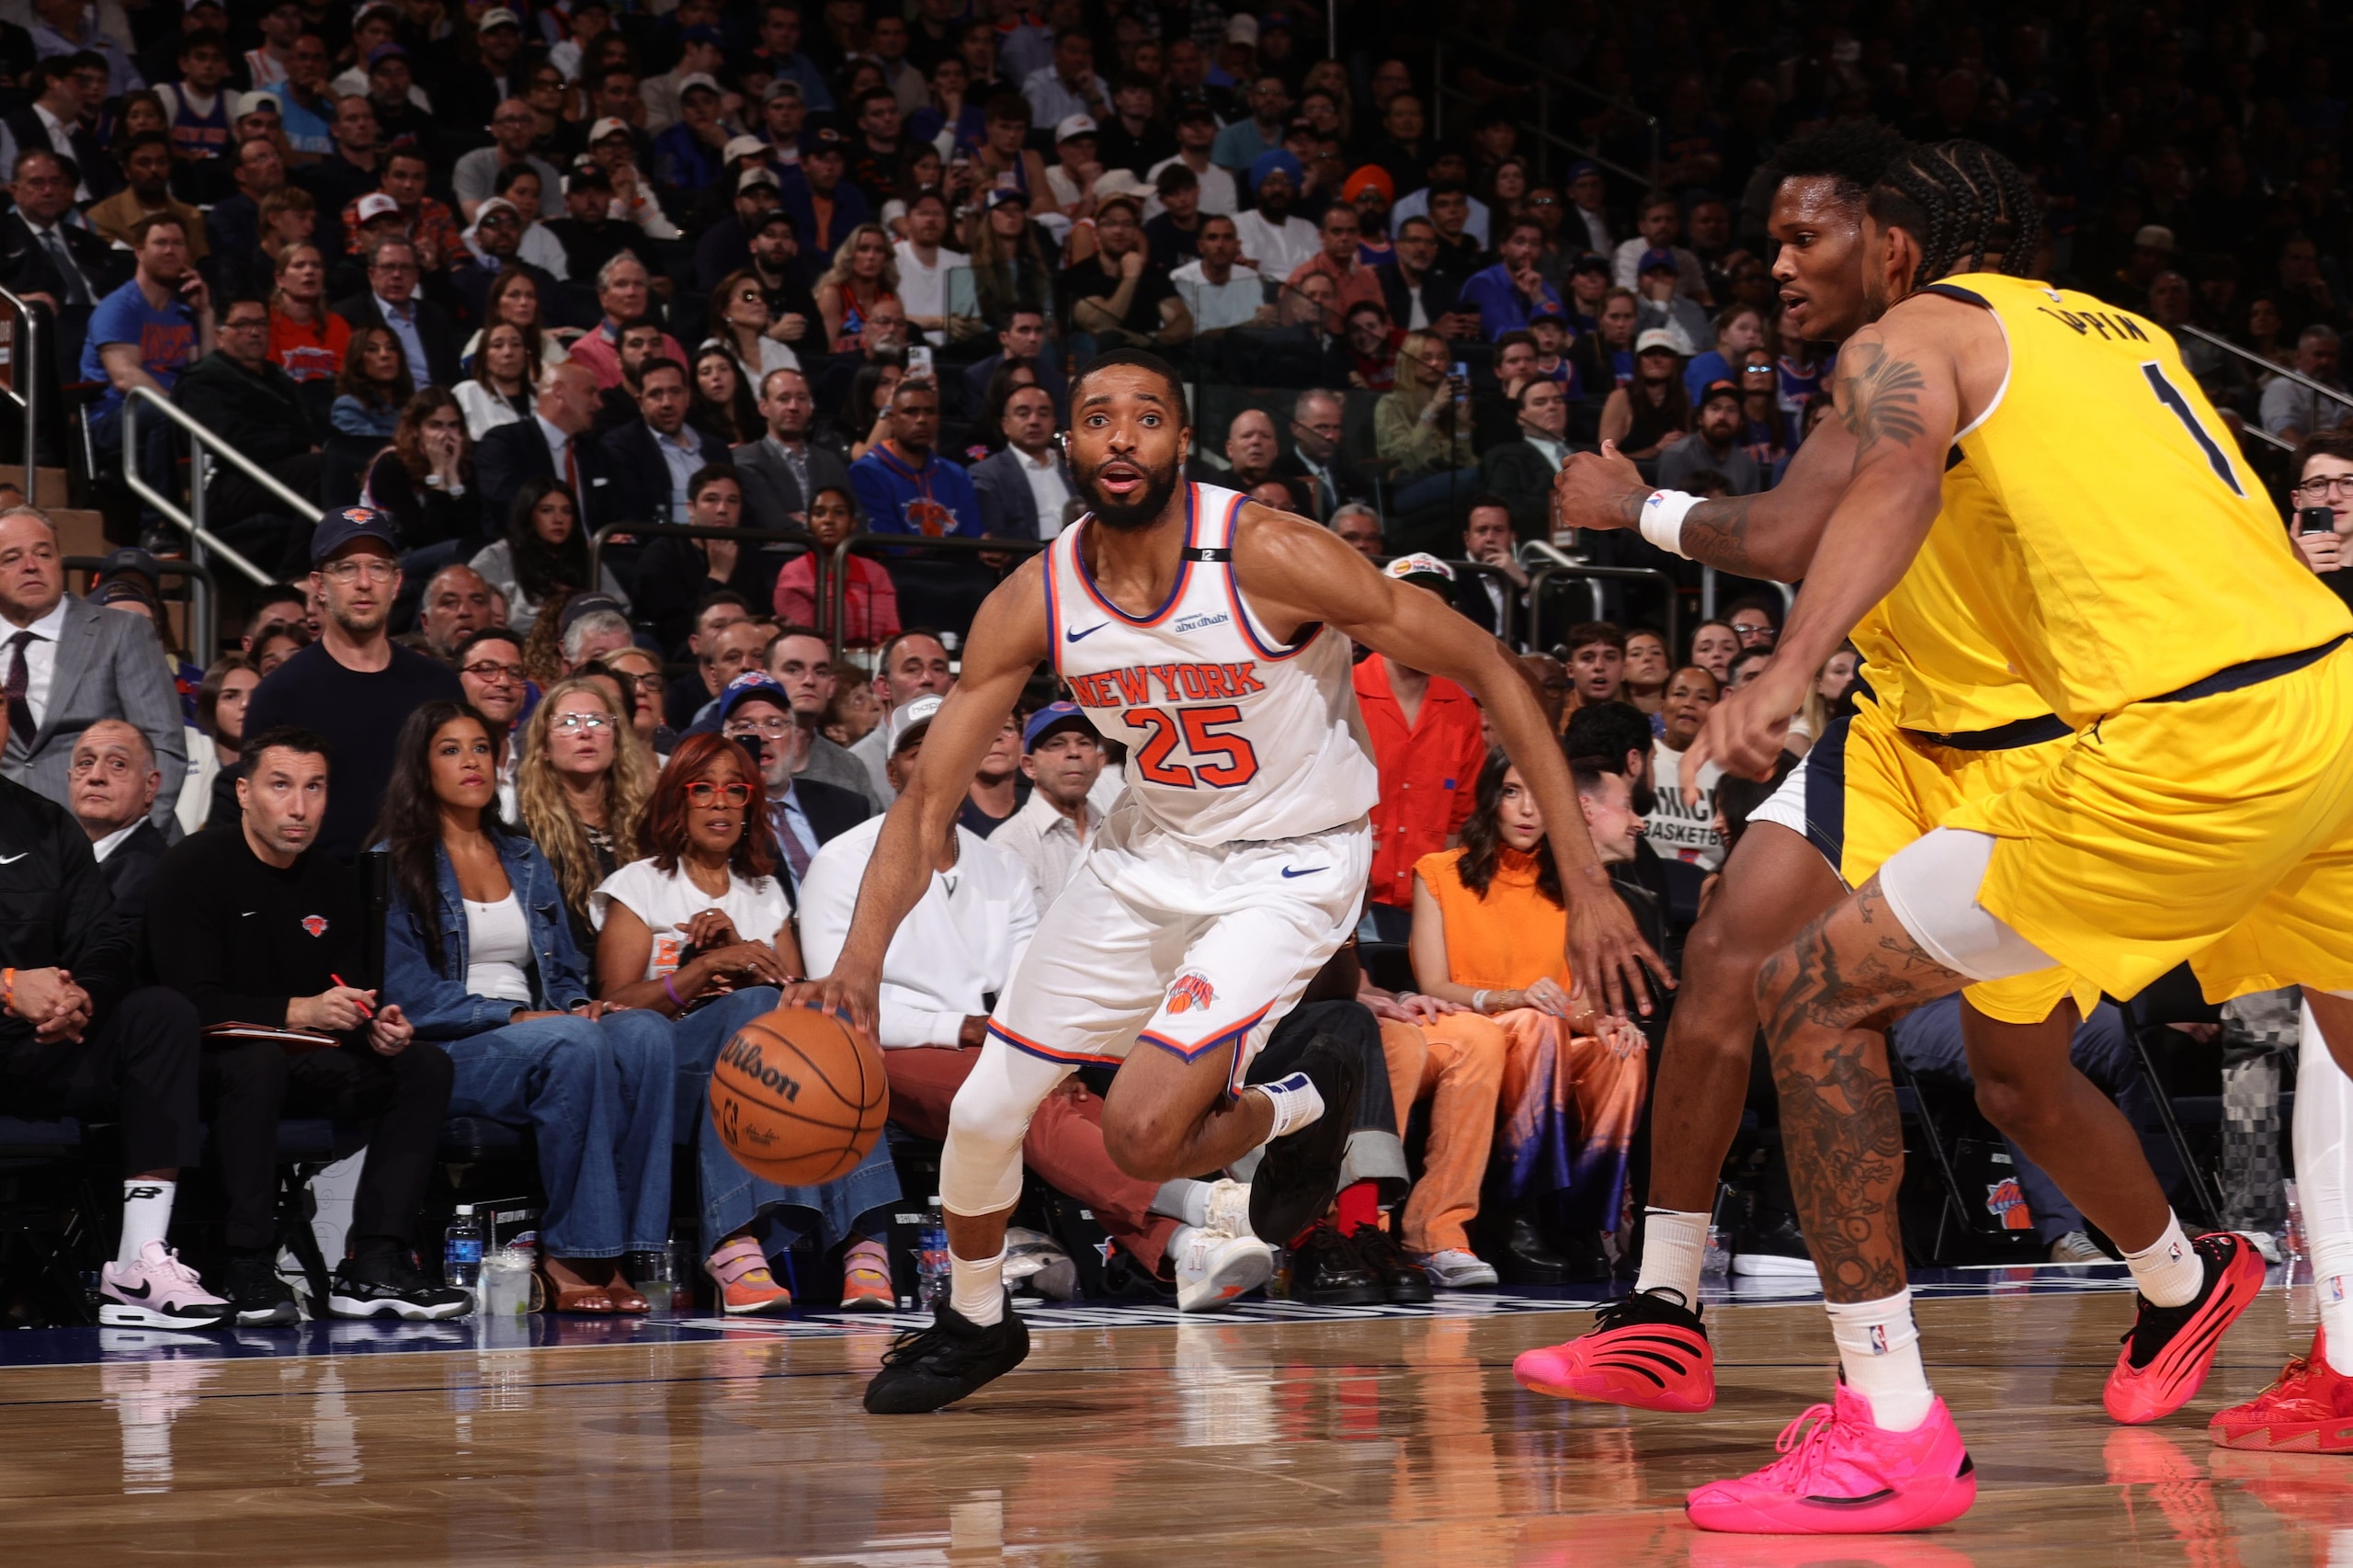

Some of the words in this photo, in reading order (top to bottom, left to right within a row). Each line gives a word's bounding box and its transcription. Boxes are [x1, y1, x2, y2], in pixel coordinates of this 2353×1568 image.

[2140, 359, 2250, 499] 1
[1200, 549, 1216, 562] 12
[1175, 622, 1197, 633] abu
[1197, 612, 1229, 628] dhabi
[1068, 665, 1150, 708] NEW
[1151, 661, 1267, 701] YORK
[1121, 704, 1260, 790] 25
[720, 1032, 801, 1104] Wilson
